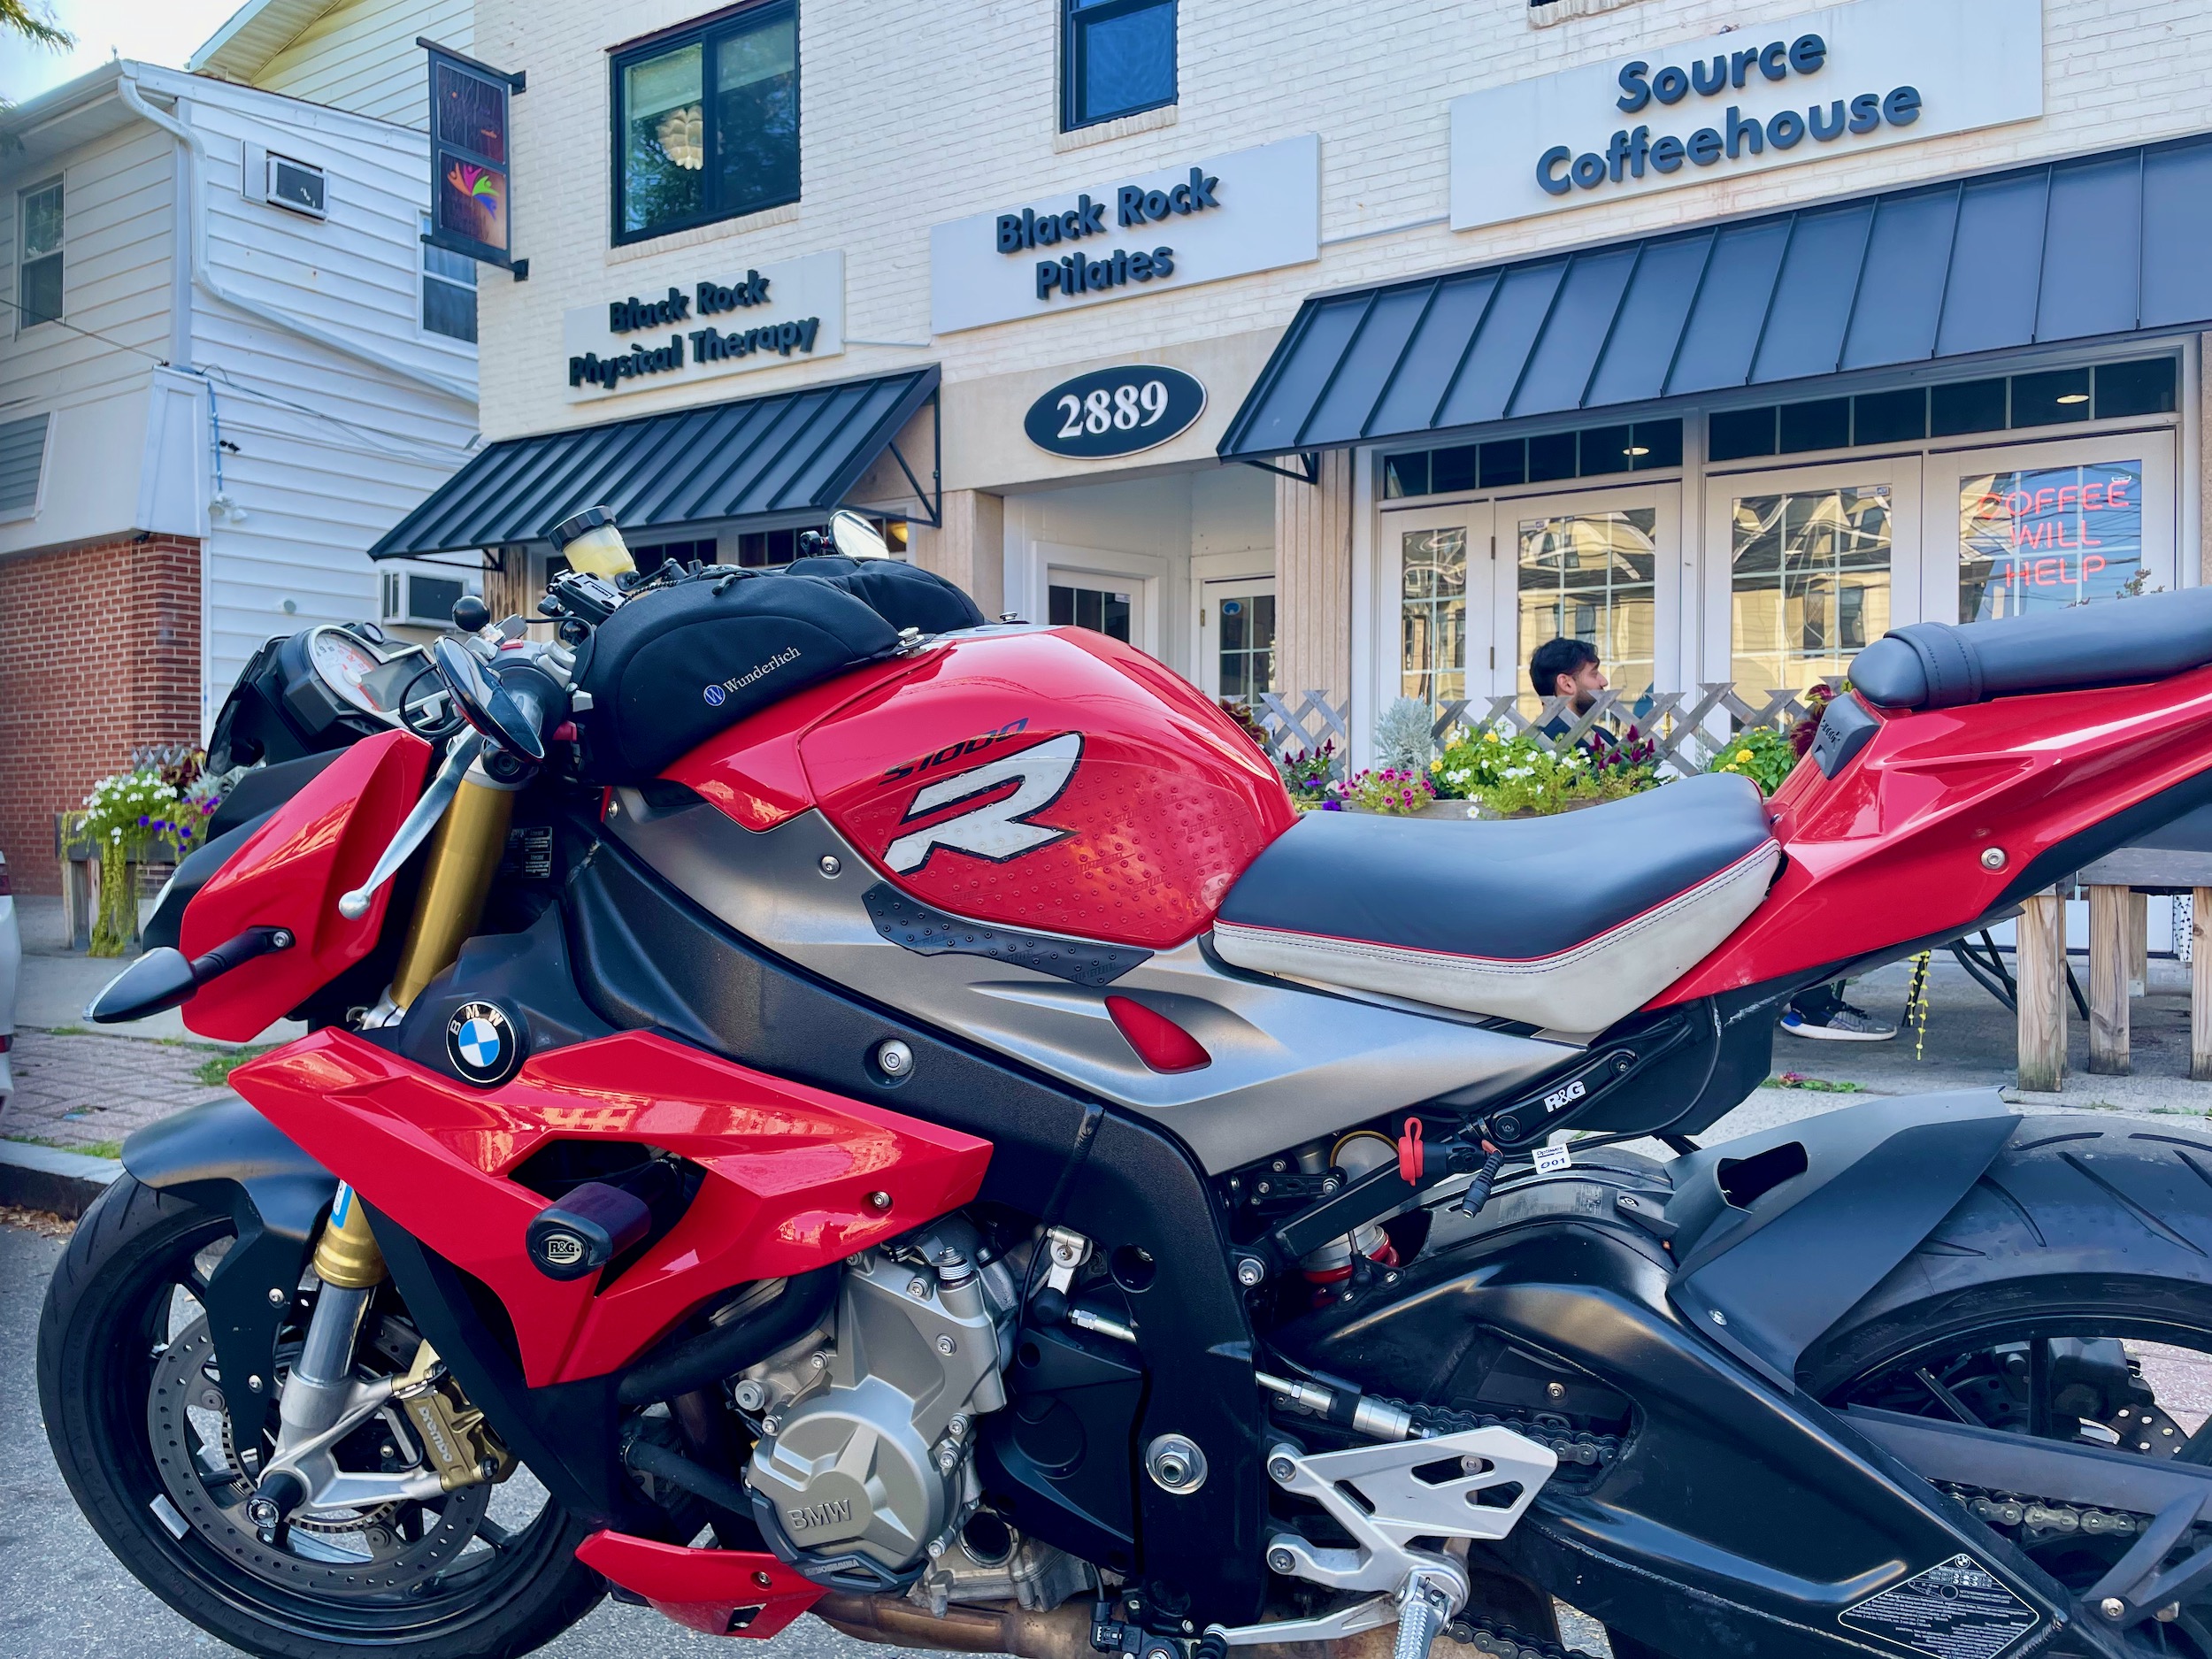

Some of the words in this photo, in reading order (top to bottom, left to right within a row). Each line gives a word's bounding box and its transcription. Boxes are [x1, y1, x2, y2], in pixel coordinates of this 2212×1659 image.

[1616, 34, 1826, 113] Source
[1536, 85, 1923, 195] Coffeehouse
[996, 194, 1107, 254] Black
[1118, 166, 1220, 227] Rock
[1036, 246, 1174, 300] Pilates
[610, 288, 690, 334] Black
[696, 269, 771, 315] Rock
[569, 334, 683, 389] Physical
[688, 317, 820, 364] Therapy
[1056, 380, 1169, 439] 2889
[1978, 480, 2130, 519] COFFEE
[2009, 519, 2101, 549] WILL
[2006, 555, 2106, 588] HELP
[722, 647, 802, 693] Wunderlich
[882, 731, 1085, 877] R
[449, 1004, 503, 1036] BMW
[1543, 1080, 1586, 1113] R&G
[550, 1242, 575, 1253] R&G
[419, 1407, 453, 1463] brembo
[787, 1497, 851, 1531] BMW
